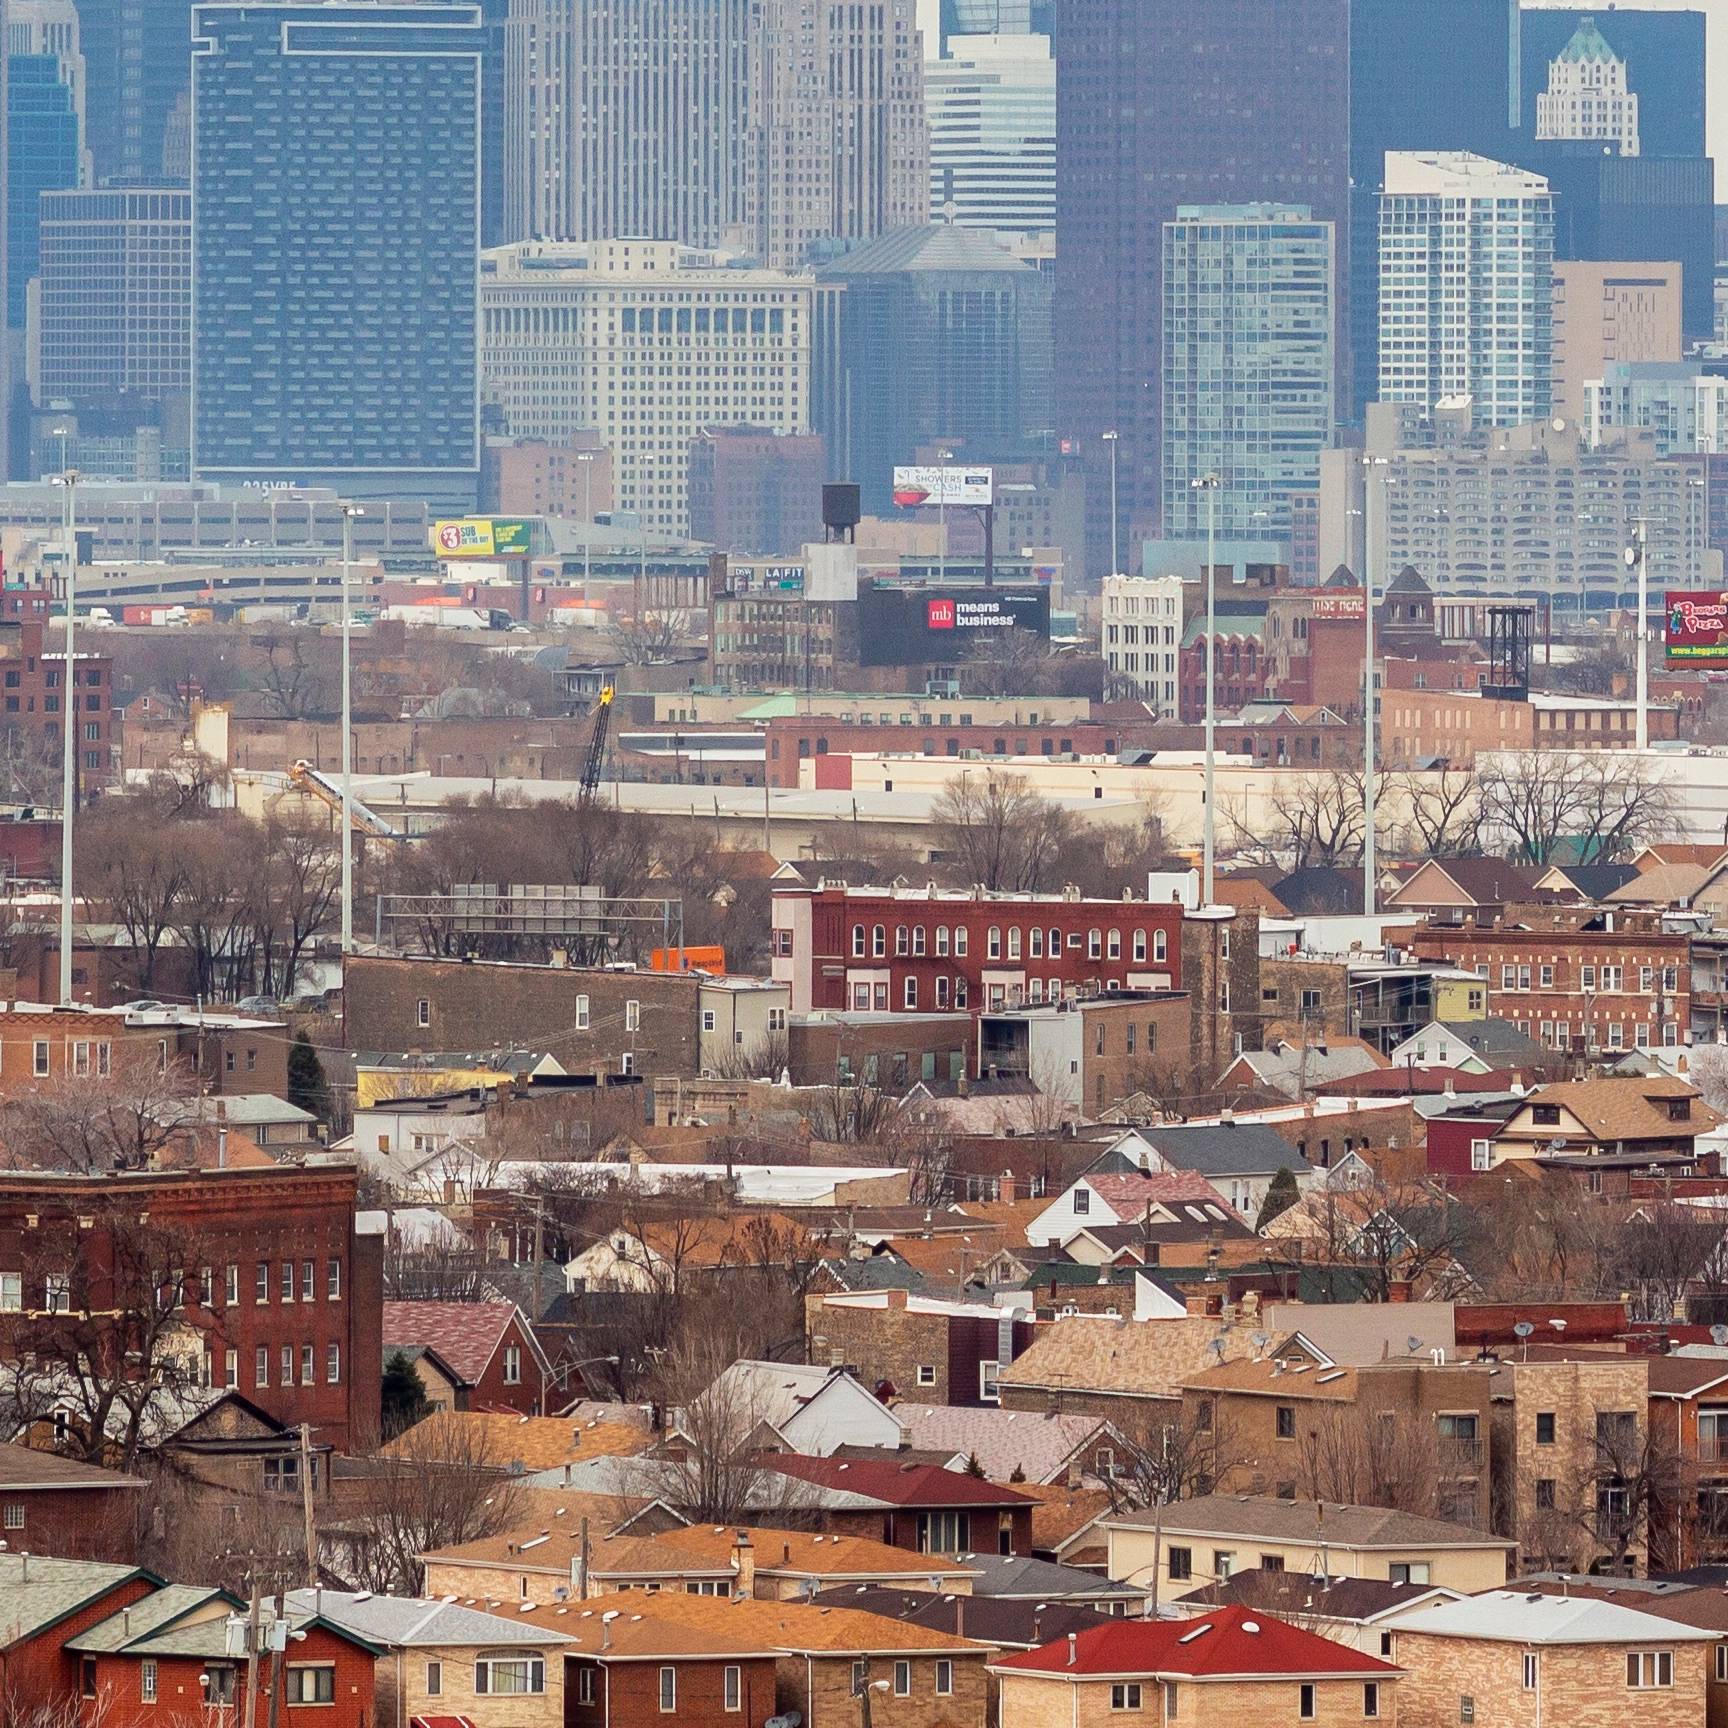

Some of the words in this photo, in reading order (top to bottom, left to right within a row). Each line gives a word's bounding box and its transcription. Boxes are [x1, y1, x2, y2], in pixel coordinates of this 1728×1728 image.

[915, 475, 962, 483] SHOWERS
[461, 526, 476, 537] SUB
[766, 569, 780, 577] LA
[931, 605, 952, 620] mb
[956, 602, 1000, 613] means
